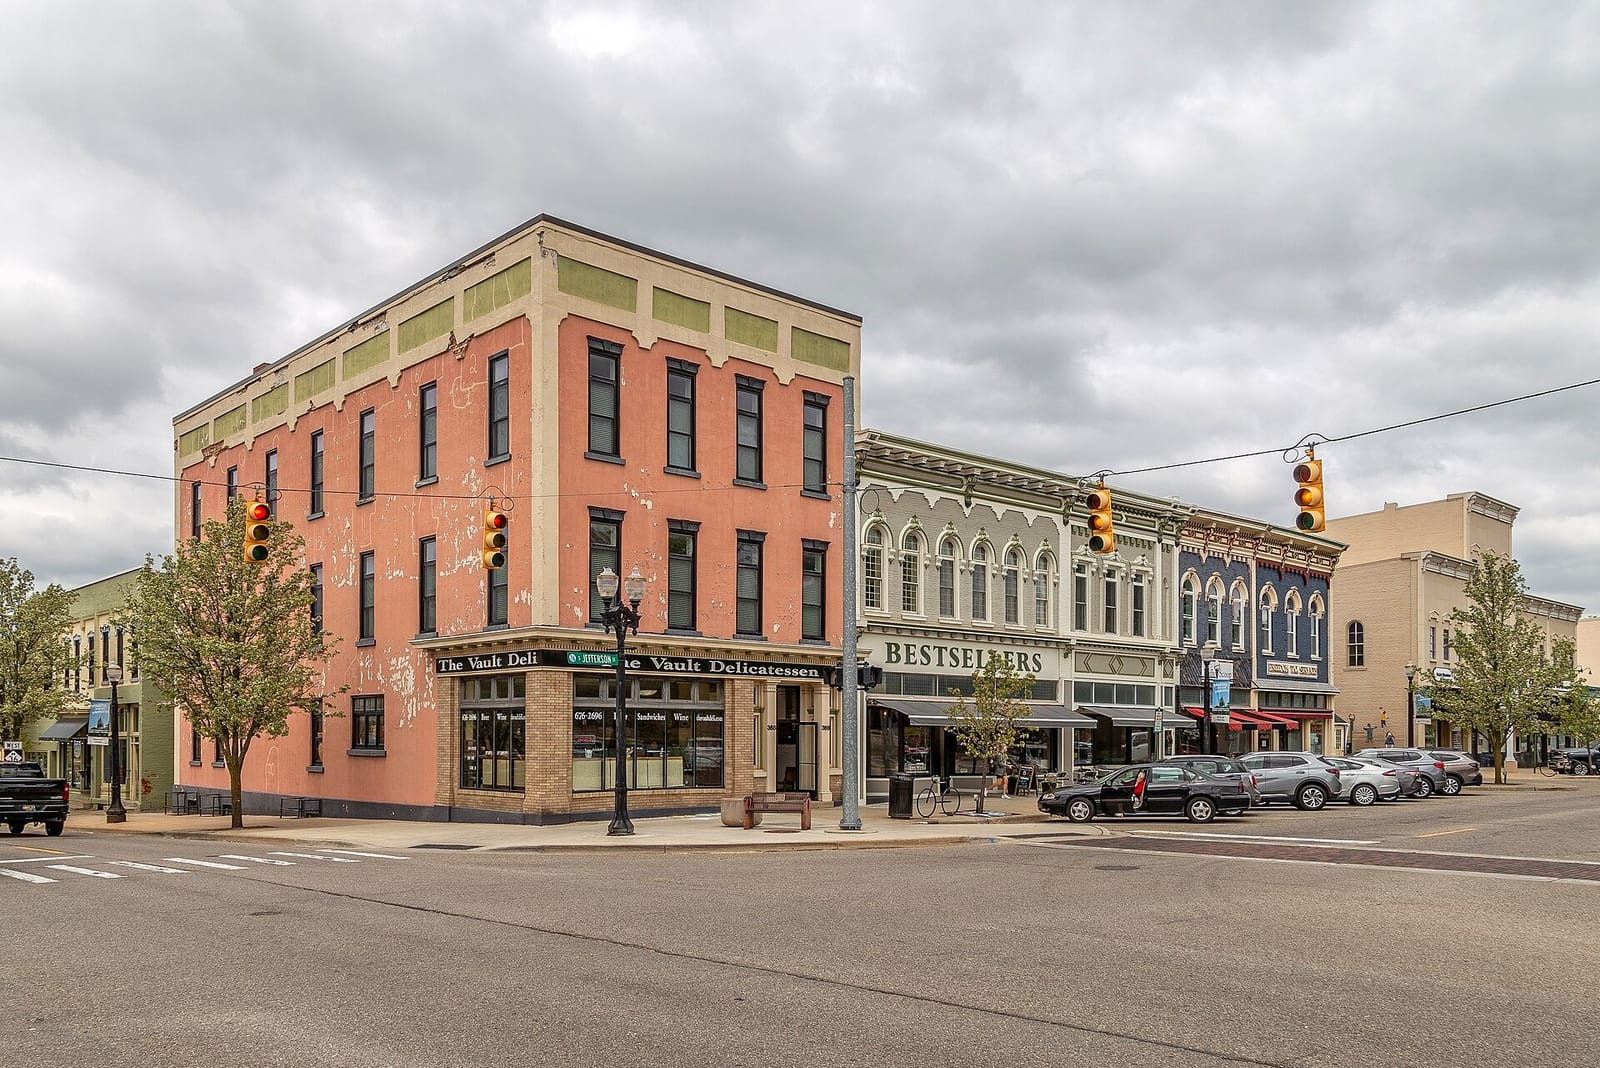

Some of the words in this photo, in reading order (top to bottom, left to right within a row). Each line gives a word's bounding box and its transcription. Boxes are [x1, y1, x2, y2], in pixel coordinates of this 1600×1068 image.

[439, 659, 463, 672] The
[468, 653, 502, 670] Vault
[507, 652, 538, 666] Deli
[582, 654, 612, 664] JEFFERSON
[885, 642, 1042, 673] BESTSELERS
[650, 656, 701, 672] Vault
[709, 660, 820, 677] Delicatessen
[636, 712, 666, 721] Sandwiches
[673, 712, 689, 721] Wine
